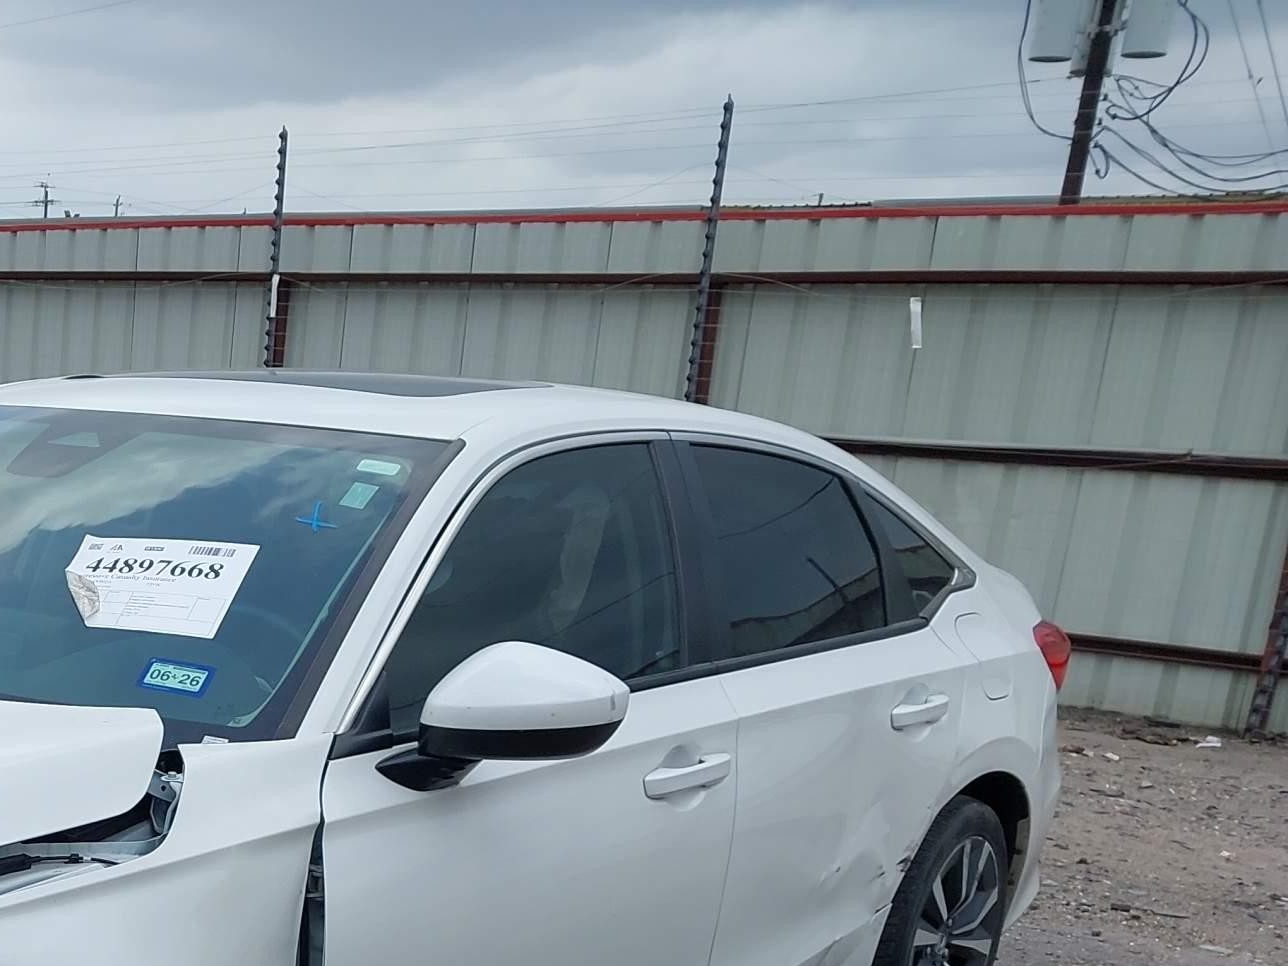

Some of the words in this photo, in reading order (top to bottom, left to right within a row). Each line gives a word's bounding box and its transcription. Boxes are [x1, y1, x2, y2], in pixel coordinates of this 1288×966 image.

[86, 557, 225, 580] 44897668
[149, 668, 172, 682] 06
[177, 673, 202, 687] 26
